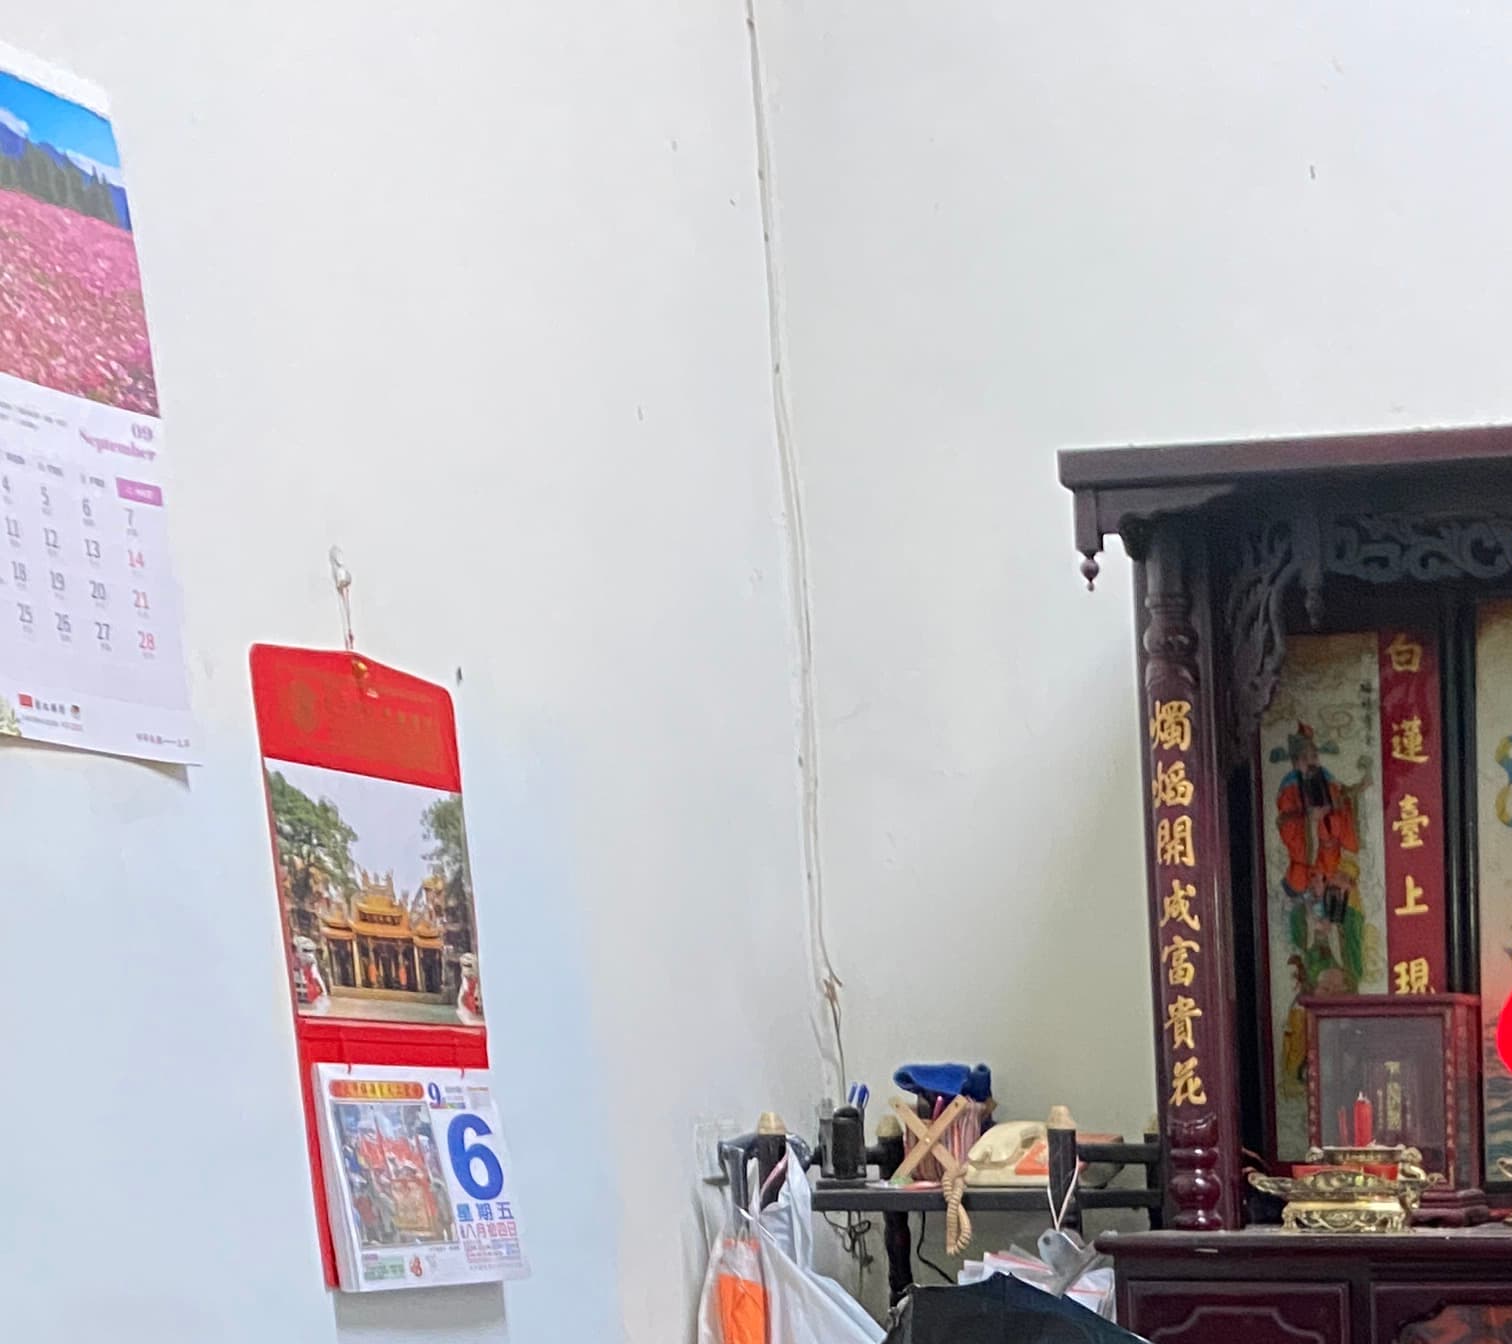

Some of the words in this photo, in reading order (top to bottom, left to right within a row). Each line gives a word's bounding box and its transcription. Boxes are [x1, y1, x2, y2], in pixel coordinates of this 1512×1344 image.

[41, 486, 50, 506] 5
[82, 498, 92, 517] 6
[124, 507, 134, 526] 7
[5, 516, 21, 539] 11
[44, 528, 60, 549] 12
[84, 538, 101, 559] 13
[128, 549, 145, 569] 14
[12, 560, 27, 582] 18
[50, 571, 65, 591] 19
[89, 580, 106, 601] 20
[132, 590, 150, 610] 21
[17, 602, 33, 624] 25
[55, 612, 72, 633] 26
[95, 622, 110, 641] 27
[138, 630, 155, 651] 28
[428, 1082, 441, 1107] 9
[447, 1113, 504, 1201] 6
[457, 1202, 514, 1222] 星期五
